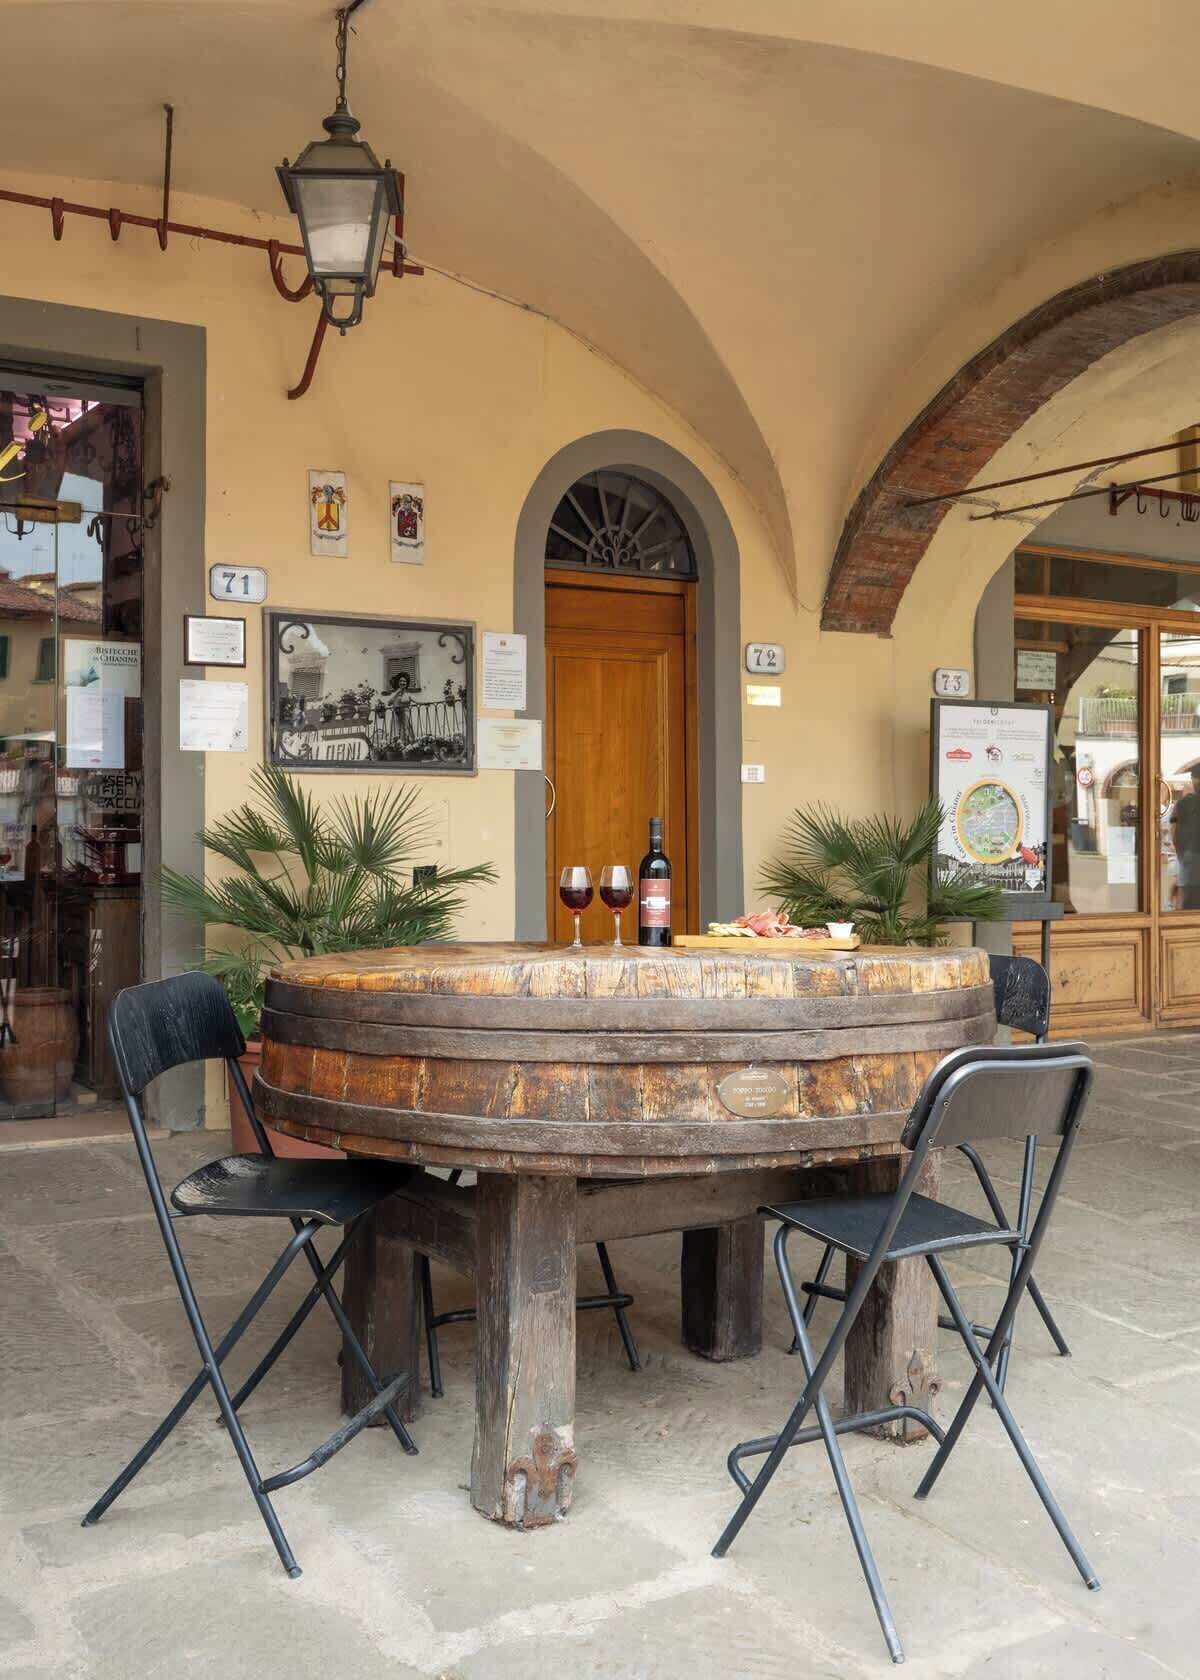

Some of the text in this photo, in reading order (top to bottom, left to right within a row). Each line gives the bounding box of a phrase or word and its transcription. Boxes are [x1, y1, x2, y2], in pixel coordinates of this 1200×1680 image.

[222, 571, 249, 595] 71
[99, 655, 138, 664] CHIANINA
[753, 648, 776, 667] 72
[941, 673, 962, 692] 73
